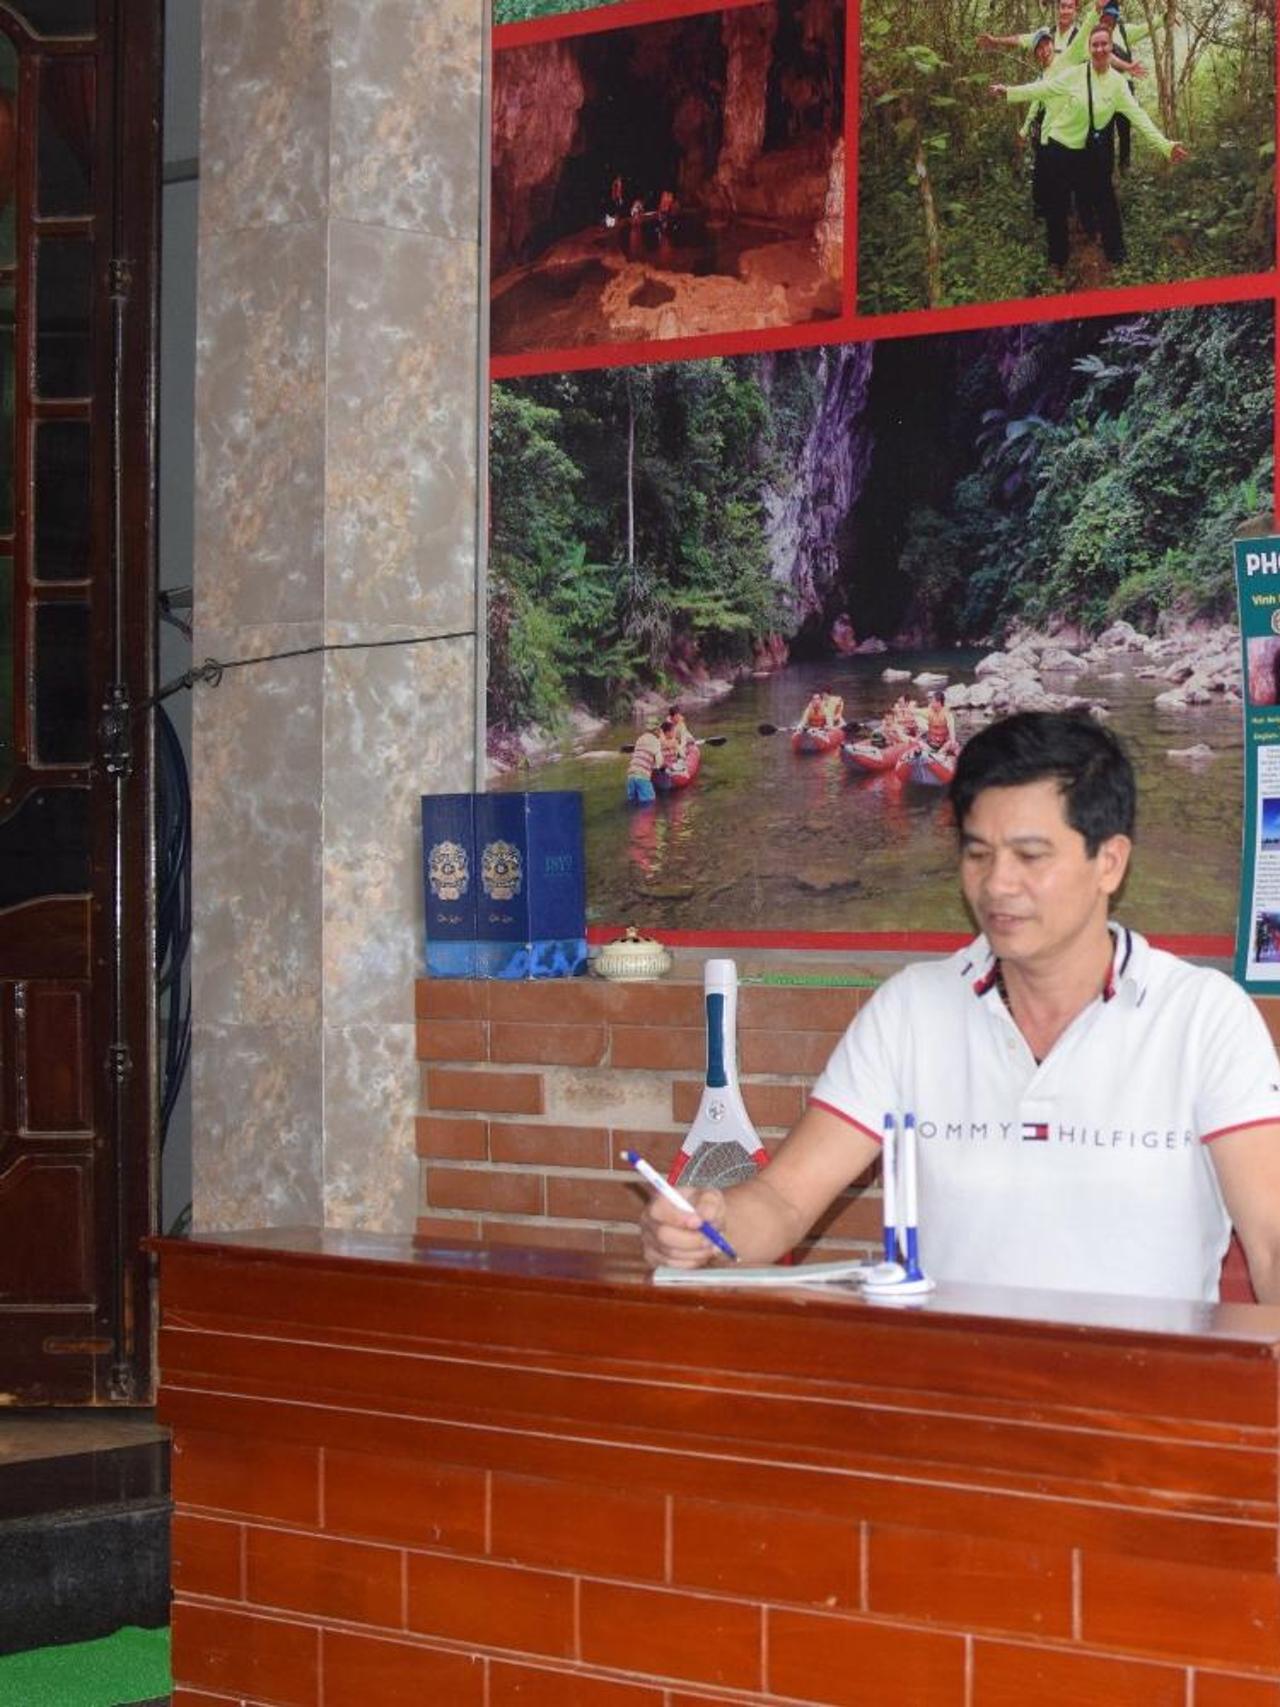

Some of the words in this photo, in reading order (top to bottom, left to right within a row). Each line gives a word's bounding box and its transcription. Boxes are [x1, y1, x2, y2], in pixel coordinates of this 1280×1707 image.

[1252, 594, 1276, 605] Vinh
[918, 1121, 1012, 1139] OMMY
[1059, 1126, 1194, 1149] HILFIGER
